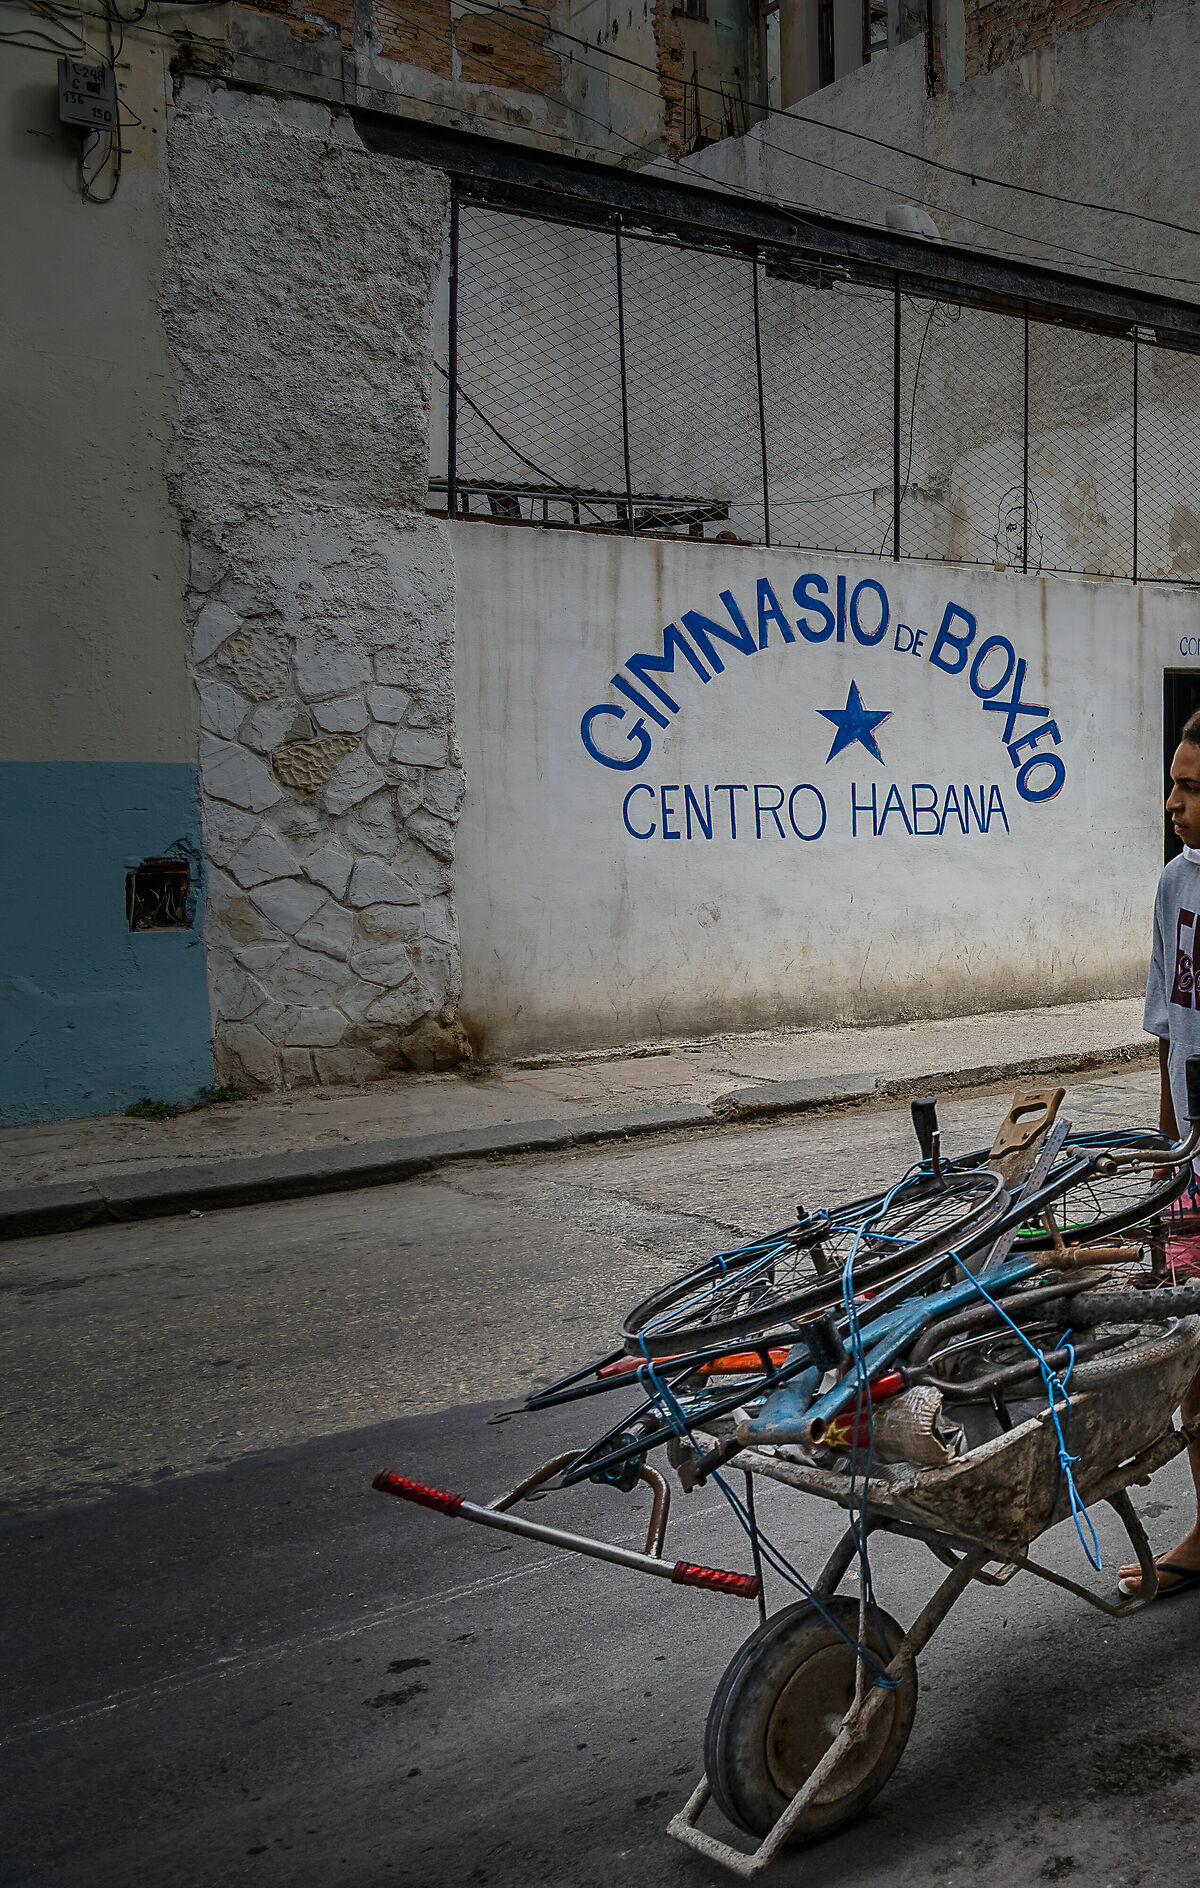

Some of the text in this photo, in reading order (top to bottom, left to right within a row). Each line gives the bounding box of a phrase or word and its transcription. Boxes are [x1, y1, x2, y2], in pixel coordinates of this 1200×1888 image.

[92, 107, 112, 122] 150
[580, 573, 1066, 803] GIMNASIO DE BOXEO
[622, 782, 1010, 842] CENTRO HABANA
